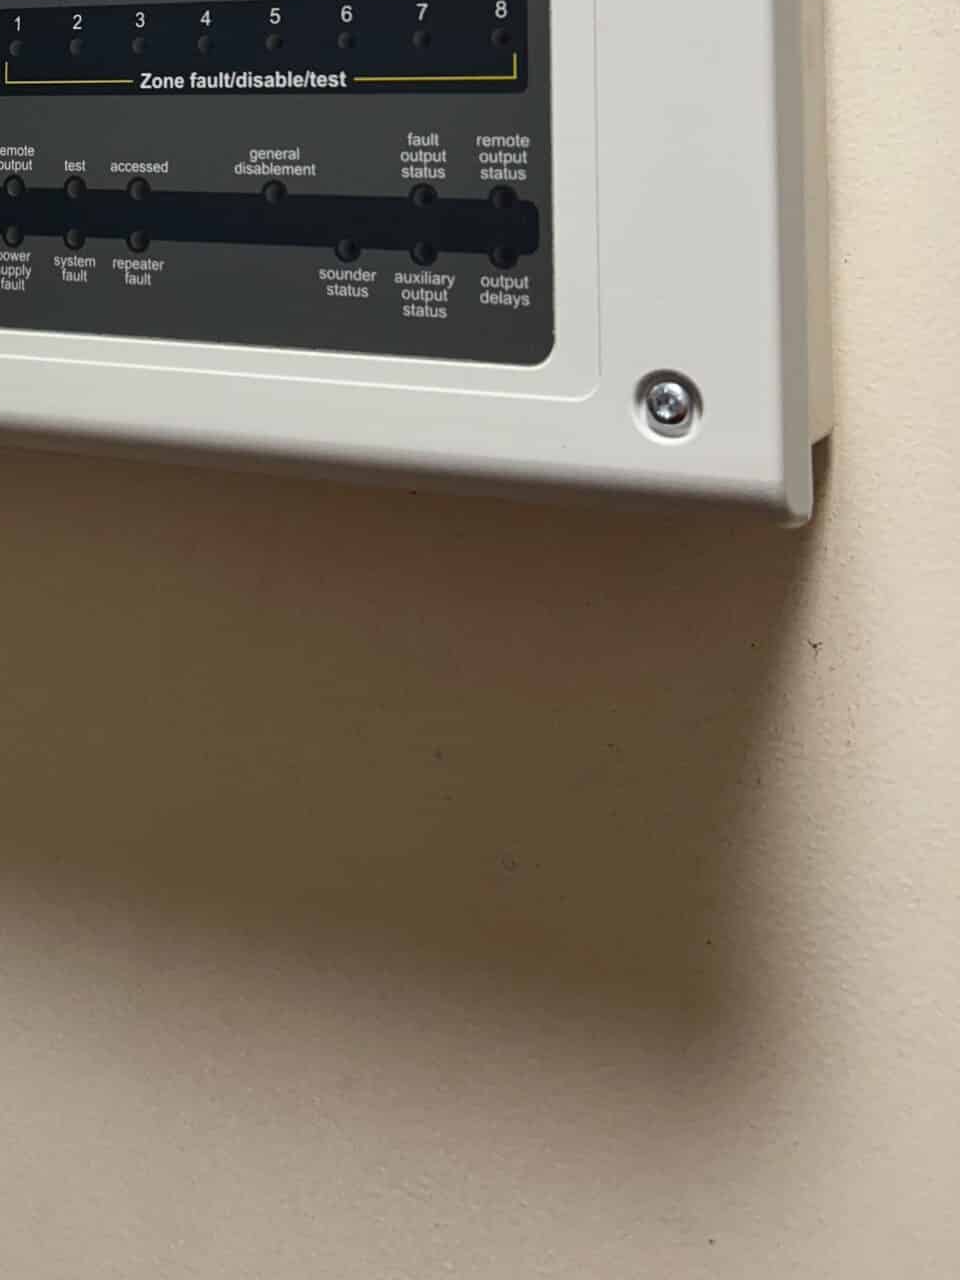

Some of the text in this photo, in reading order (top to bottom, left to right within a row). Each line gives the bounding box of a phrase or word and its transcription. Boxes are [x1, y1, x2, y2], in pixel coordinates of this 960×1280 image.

[14, 0, 508, 32] 1 2 3 4 5 6 7 8
[140, 70, 347, 89] Zone fault/disable/test
[407, 132, 440, 147] fault
[475, 134, 531, 148] remote
[249, 148, 300, 163] general
[400, 149, 447, 165] output
[478, 150, 528, 166] output
[64, 160, 86, 171] test
[110, 160, 169, 173] accessed
[234, 161, 317, 177] disablement
[401, 166, 446, 180] status
[480, 167, 527, 181] status
[53, 255, 96, 269] system
[112, 257, 165, 273] repeater
[62, 269, 88, 283] fault
[124, 271, 152, 287] fault
[319, 268, 377, 282] sounder
[394, 271, 456, 289] auxiliary
[0, 278, 25, 291] fault
[326, 283, 369, 298] status
[480, 276, 529, 291] output
[401, 288, 448, 304] output
[479, 291, 531, 309] delays
[402, 305, 448, 320] status
